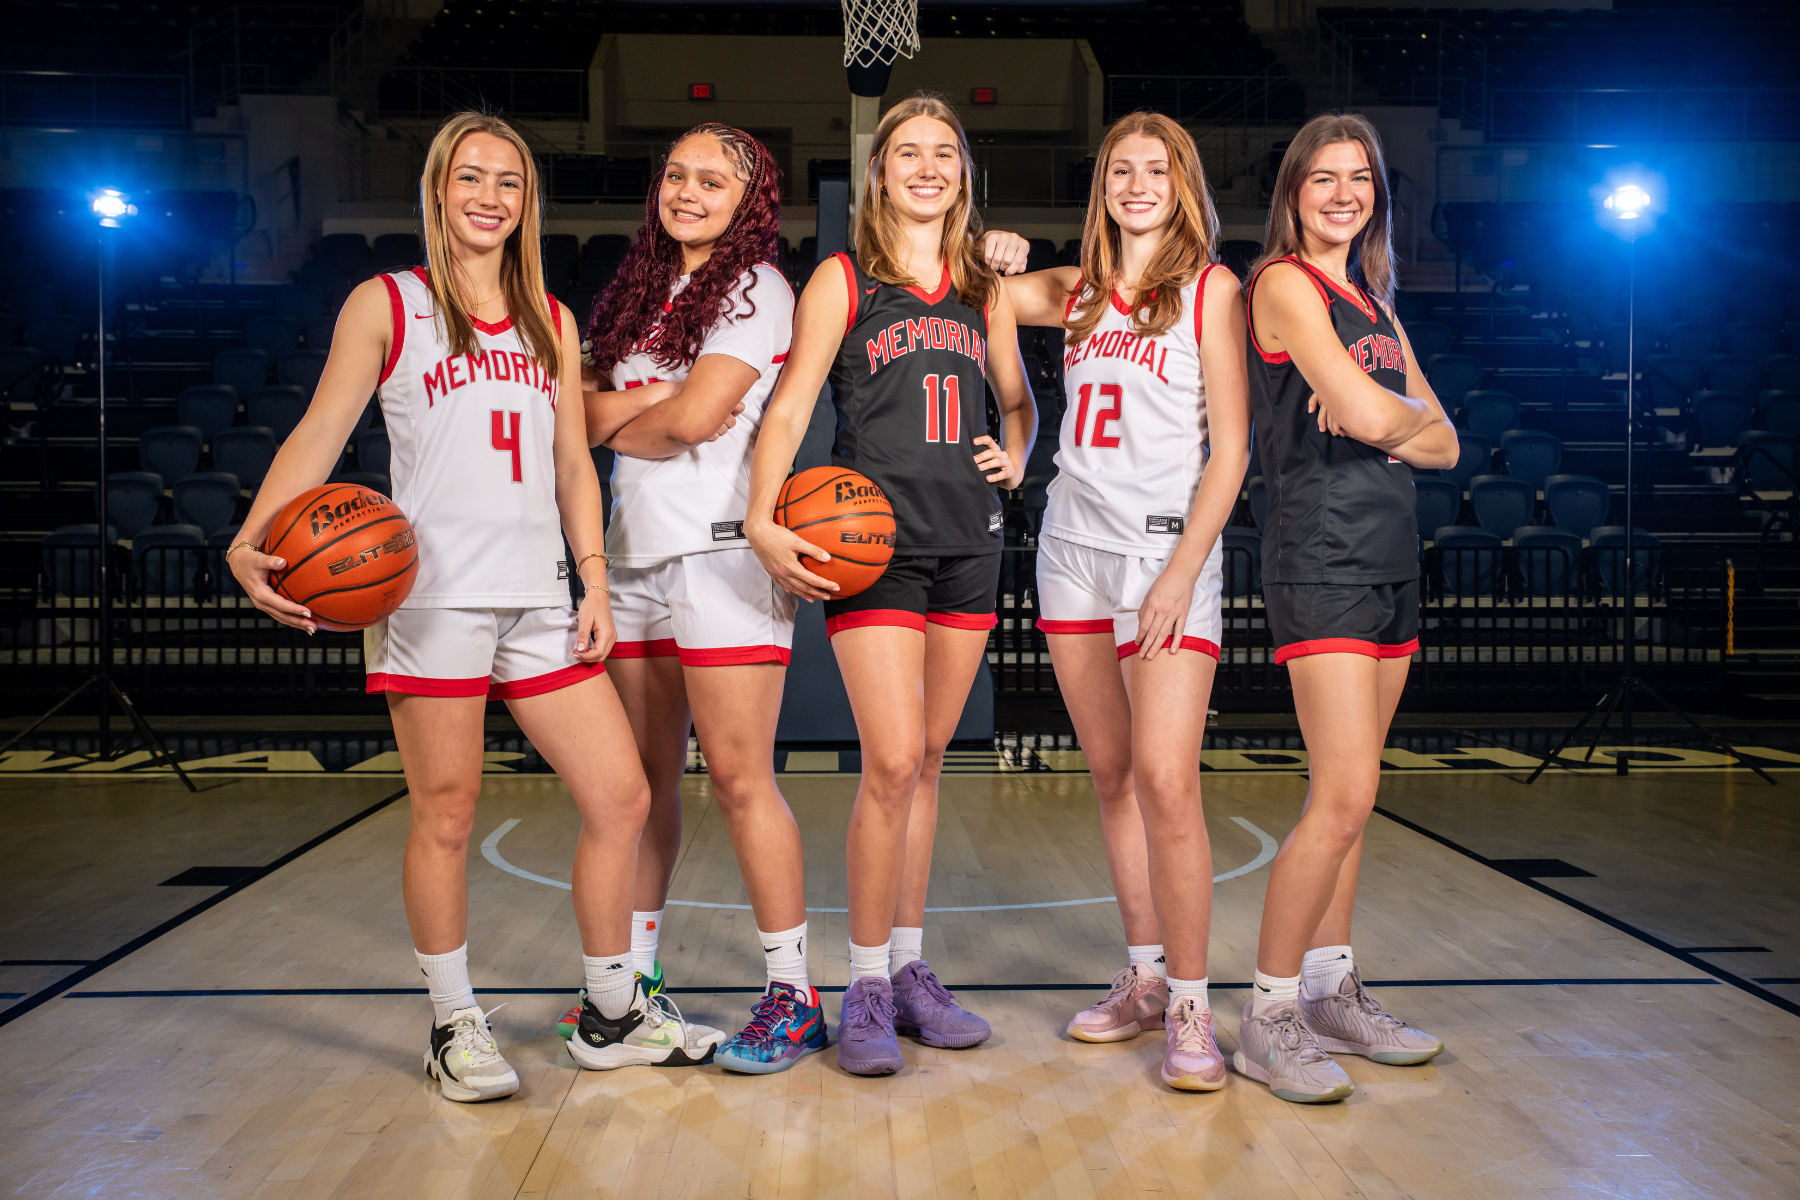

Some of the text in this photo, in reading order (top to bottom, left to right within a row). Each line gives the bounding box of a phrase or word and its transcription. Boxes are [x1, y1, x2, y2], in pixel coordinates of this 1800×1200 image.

[923, 373, 961, 444] 11
[1075, 382, 1124, 449] 12
[489, 408, 523, 484] 4
[310, 490, 391, 539] Baden
[1171, 521, 1179, 530] M
[327, 539, 397, 577] ELITE
